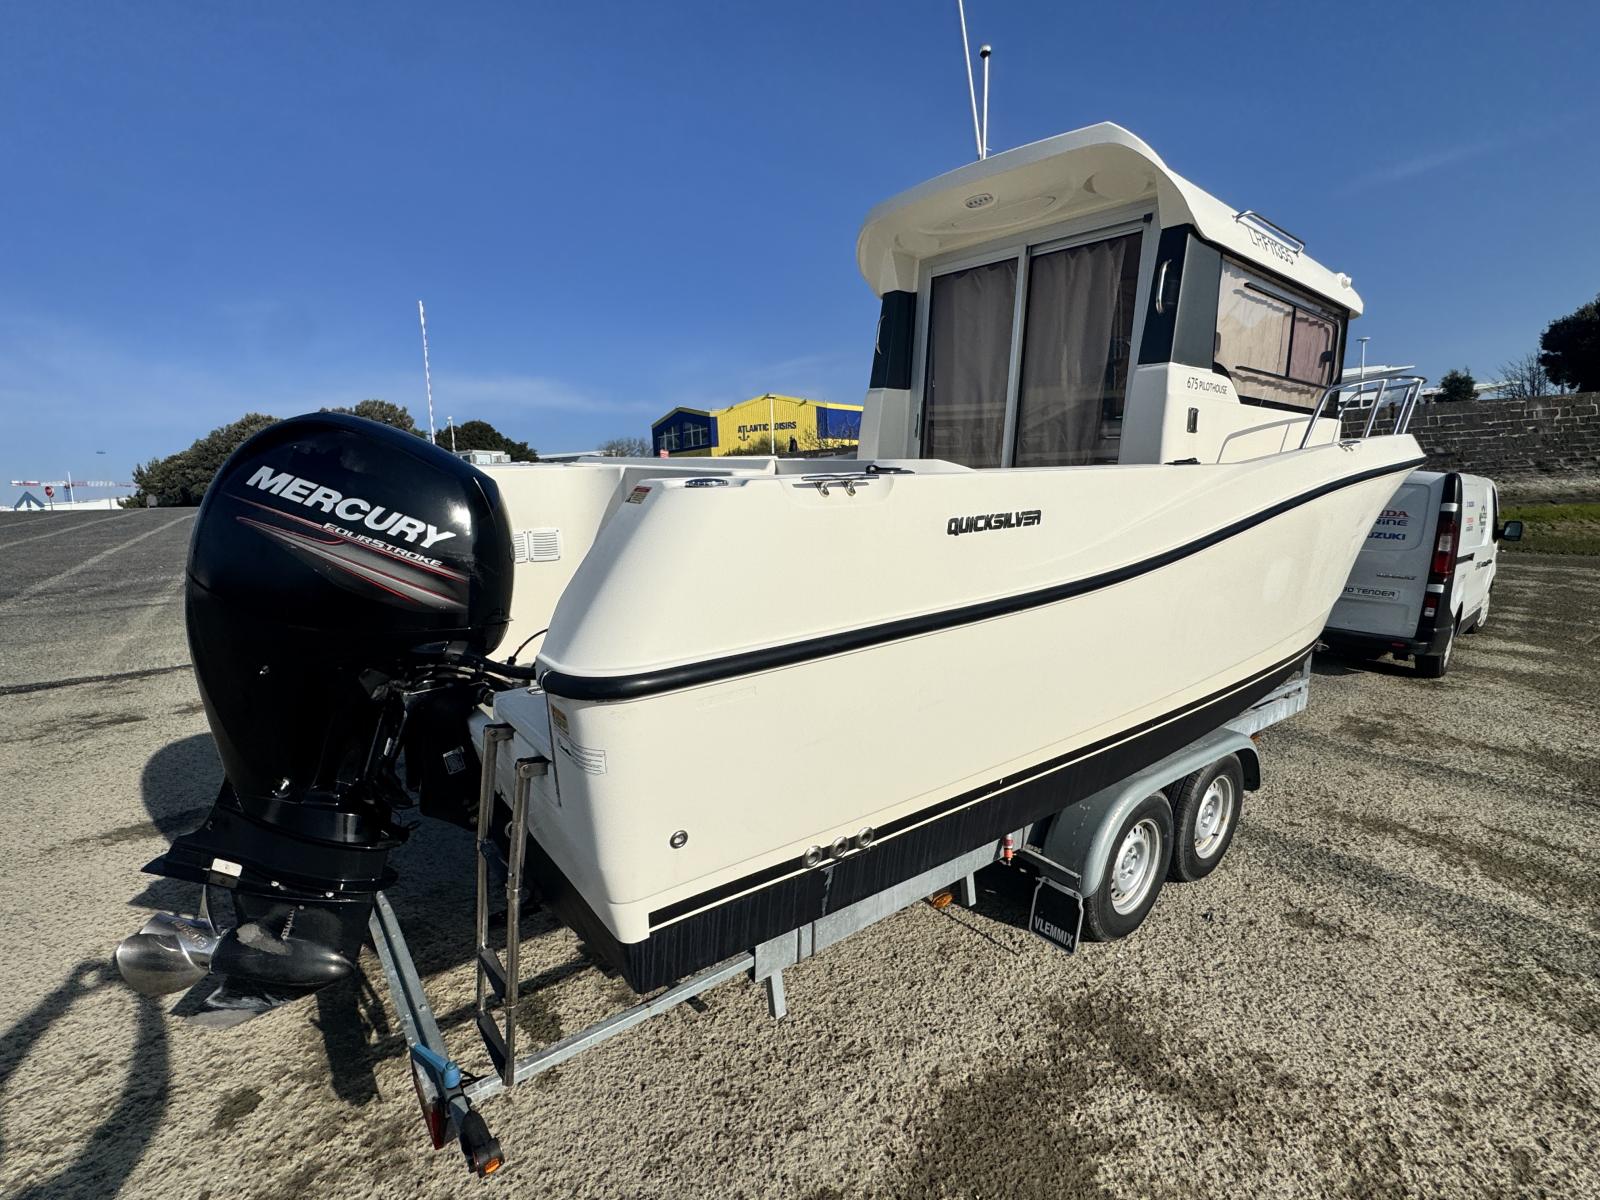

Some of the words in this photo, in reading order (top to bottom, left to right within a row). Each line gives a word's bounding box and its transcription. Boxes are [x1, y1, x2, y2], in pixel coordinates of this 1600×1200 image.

[1186, 377, 1199, 390] 675
[1199, 381, 1228, 394] PILOTHOUSE
[737, 424, 768, 438] ATLANTIC
[772, 421, 797, 431] OISIRS
[247, 466, 456, 548] MERCURY
[947, 510, 1041, 536] QUICKSILVER
[323, 522, 443, 567] FOURSTROKE
[1034, 915, 1074, 947] VLEMMIX
